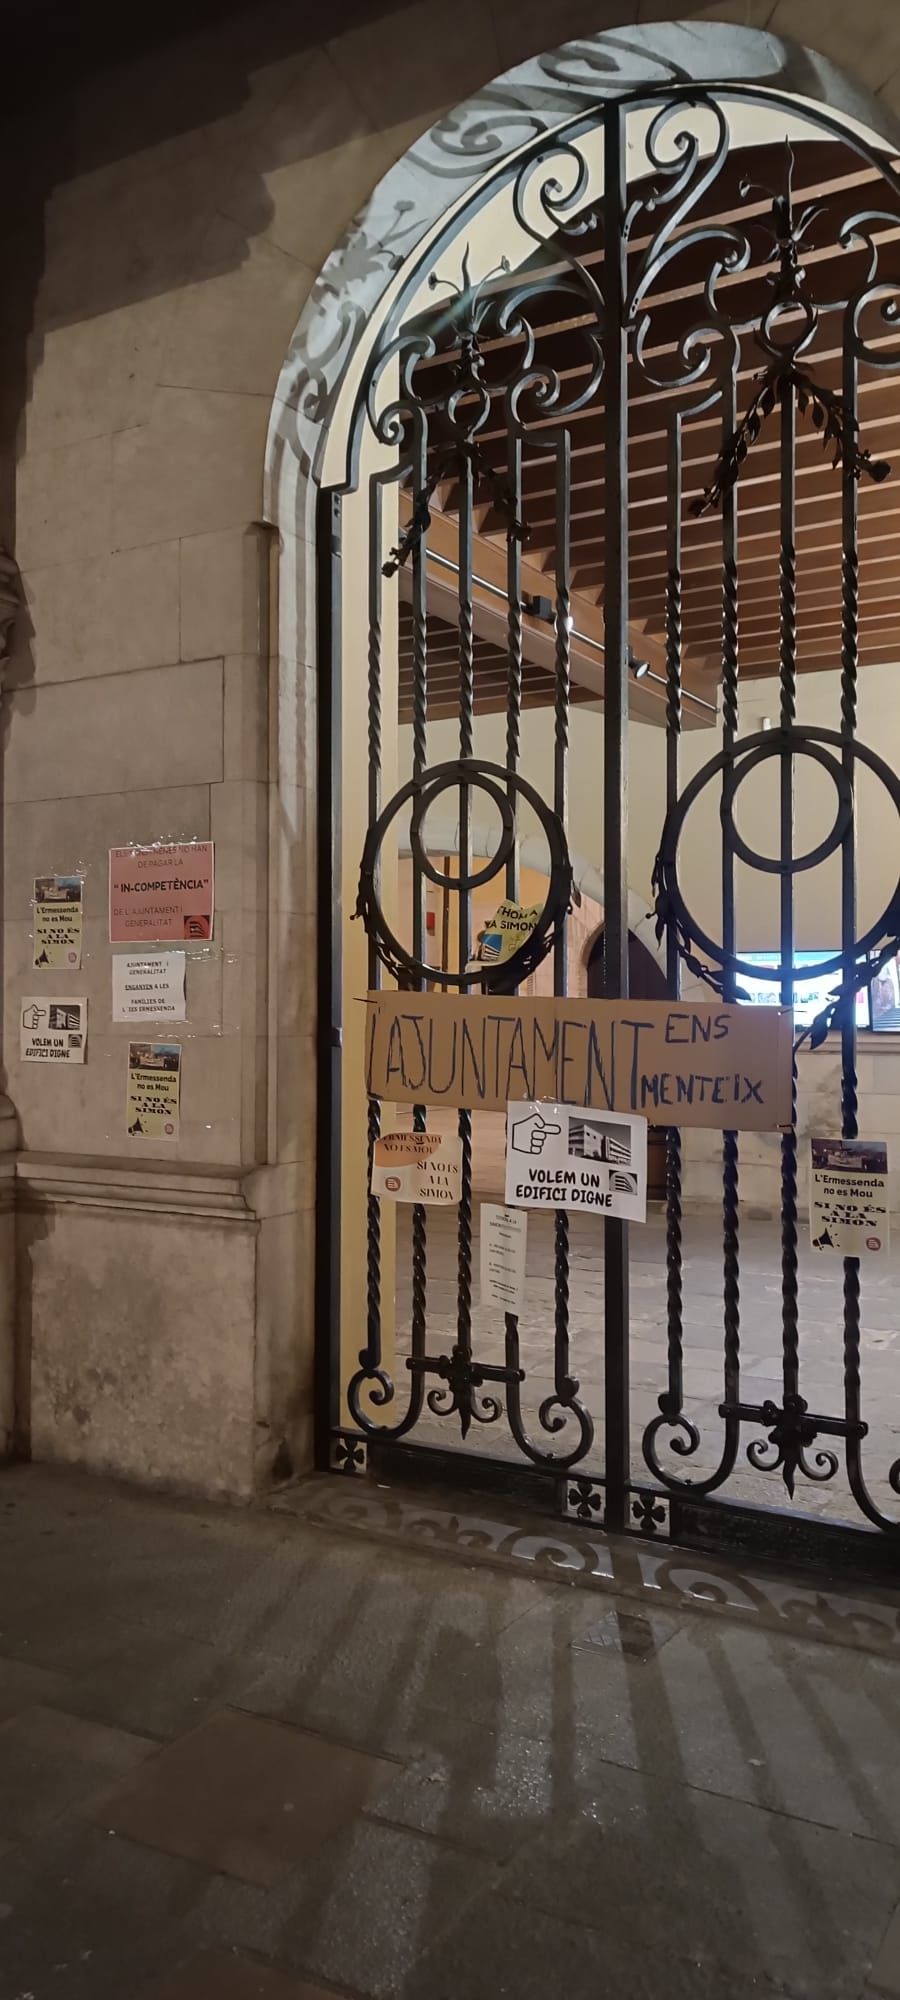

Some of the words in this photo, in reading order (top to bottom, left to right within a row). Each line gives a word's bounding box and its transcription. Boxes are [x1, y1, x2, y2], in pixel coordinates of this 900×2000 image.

[191, 844, 208, 852] HAN
[137, 860, 148, 869] DE
[174, 857, 184, 866] LA
[59, 914, 73, 922] Mou
[124, 918, 173, 928] GENERALITAT
[664, 1013, 733, 1044] ENS
[31, 1037, 52, 1046] VOLEM
[53, 1039, 64, 1047] UN
[25, 1048, 49, 1057] EDIFICI
[49, 1049, 71, 1058] DIGNE
[130, 1072, 177, 1083] L'Ermessenda
[155, 1083, 170, 1091] Mou
[135, 1107, 172, 1115] SIMON
[383, 1143, 399, 1152] NO
[416, 1160, 428, 1171] SI
[430, 1161, 446, 1172] NO
[528, 1167, 577, 1185] VOLEM
[580, 1172, 601, 1188] UN
[814, 1173, 885, 1188] L'Ermessenda
[419, 1188, 454, 1200] SIMON
[515, 1184, 567, 1202] EDIFICI
[570, 1188, 614, 1207] DIGNE
[823, 1187, 836, 1195] no
[836, 1188, 848, 1196] es
[849, 1188, 873, 1198] Mou
[814, 1201, 831, 1209] SI
[834, 1203, 858, 1212] NO
[845, 1211, 867, 1219] LA
[821, 1215, 878, 1227] SIMON
